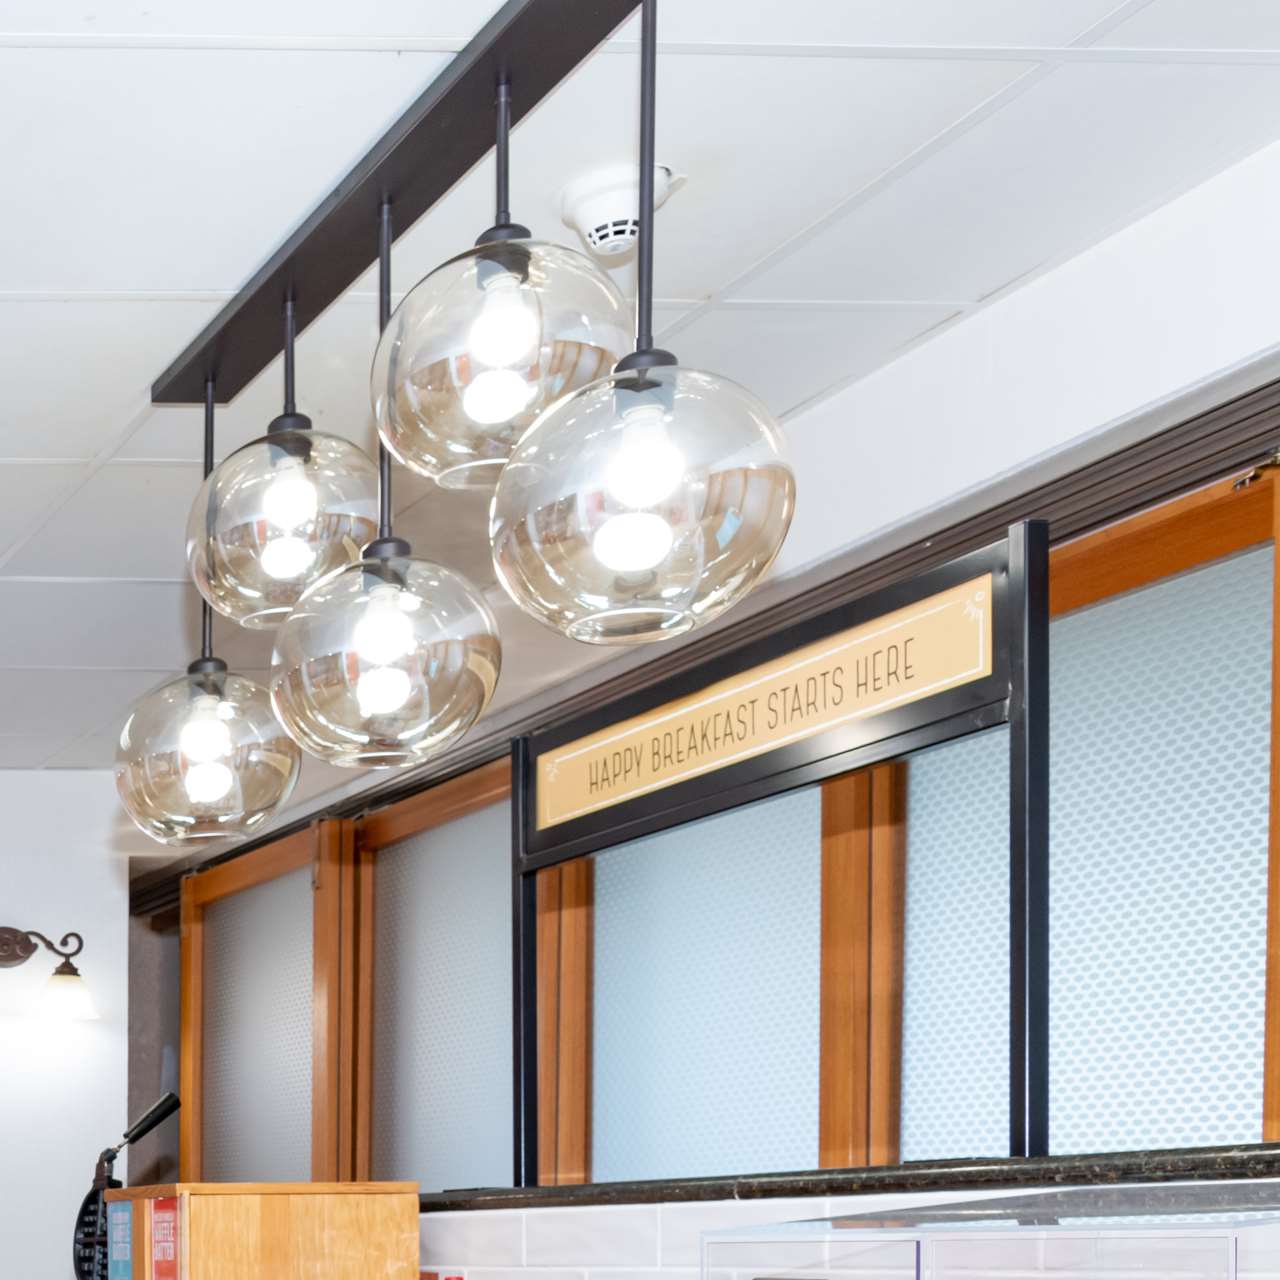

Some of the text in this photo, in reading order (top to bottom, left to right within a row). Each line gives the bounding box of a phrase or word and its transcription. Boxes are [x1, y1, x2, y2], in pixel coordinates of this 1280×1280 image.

[588, 638, 916, 795] HAPPY BREAKFAST STARTS HERE
